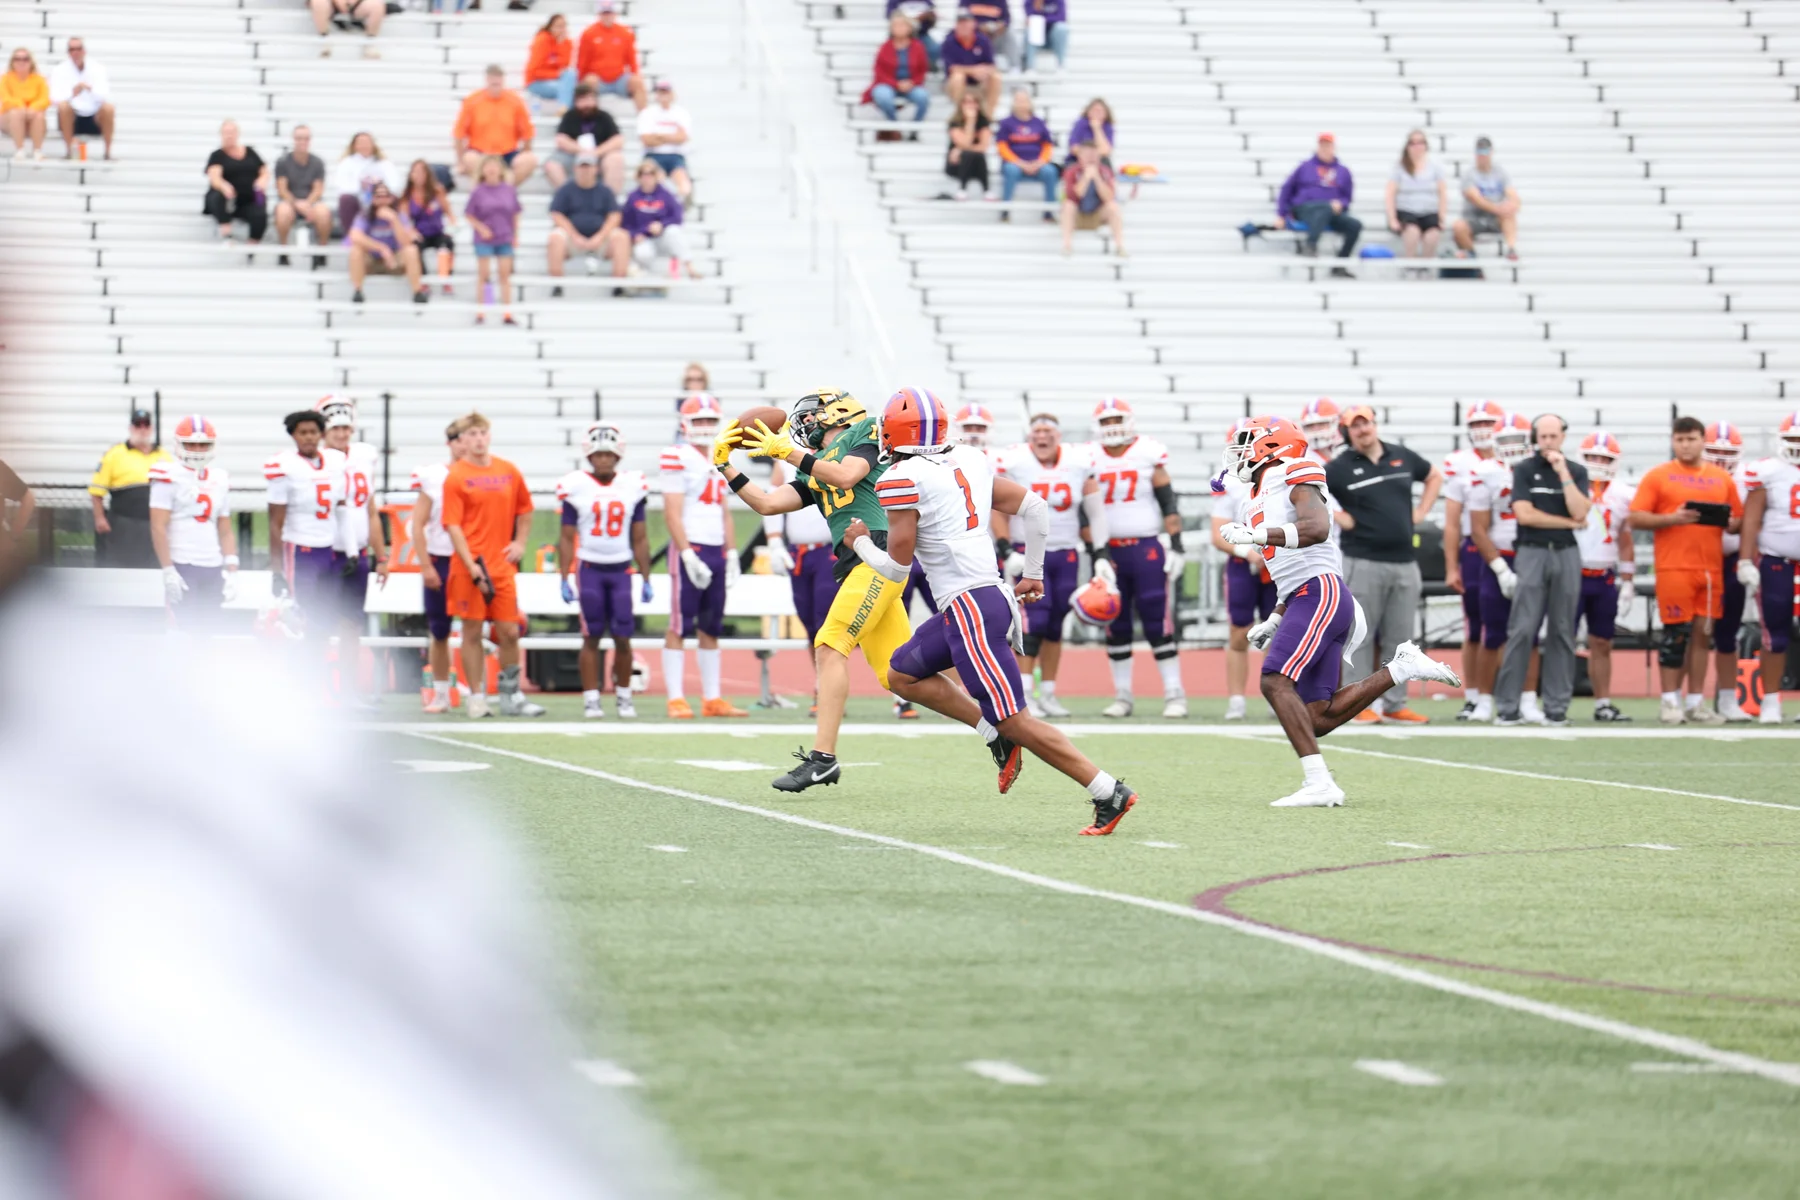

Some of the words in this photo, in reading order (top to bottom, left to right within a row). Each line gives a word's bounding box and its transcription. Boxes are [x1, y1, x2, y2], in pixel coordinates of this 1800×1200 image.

[315, 483, 332, 520] 5
[954, 468, 978, 531] 1
[1030, 483, 1073, 512] 73
[1098, 470, 1139, 505] 77
[194, 493, 212, 523] 3
[590, 500, 625, 537] 18
[847, 575, 884, 638] BROCKPORT
